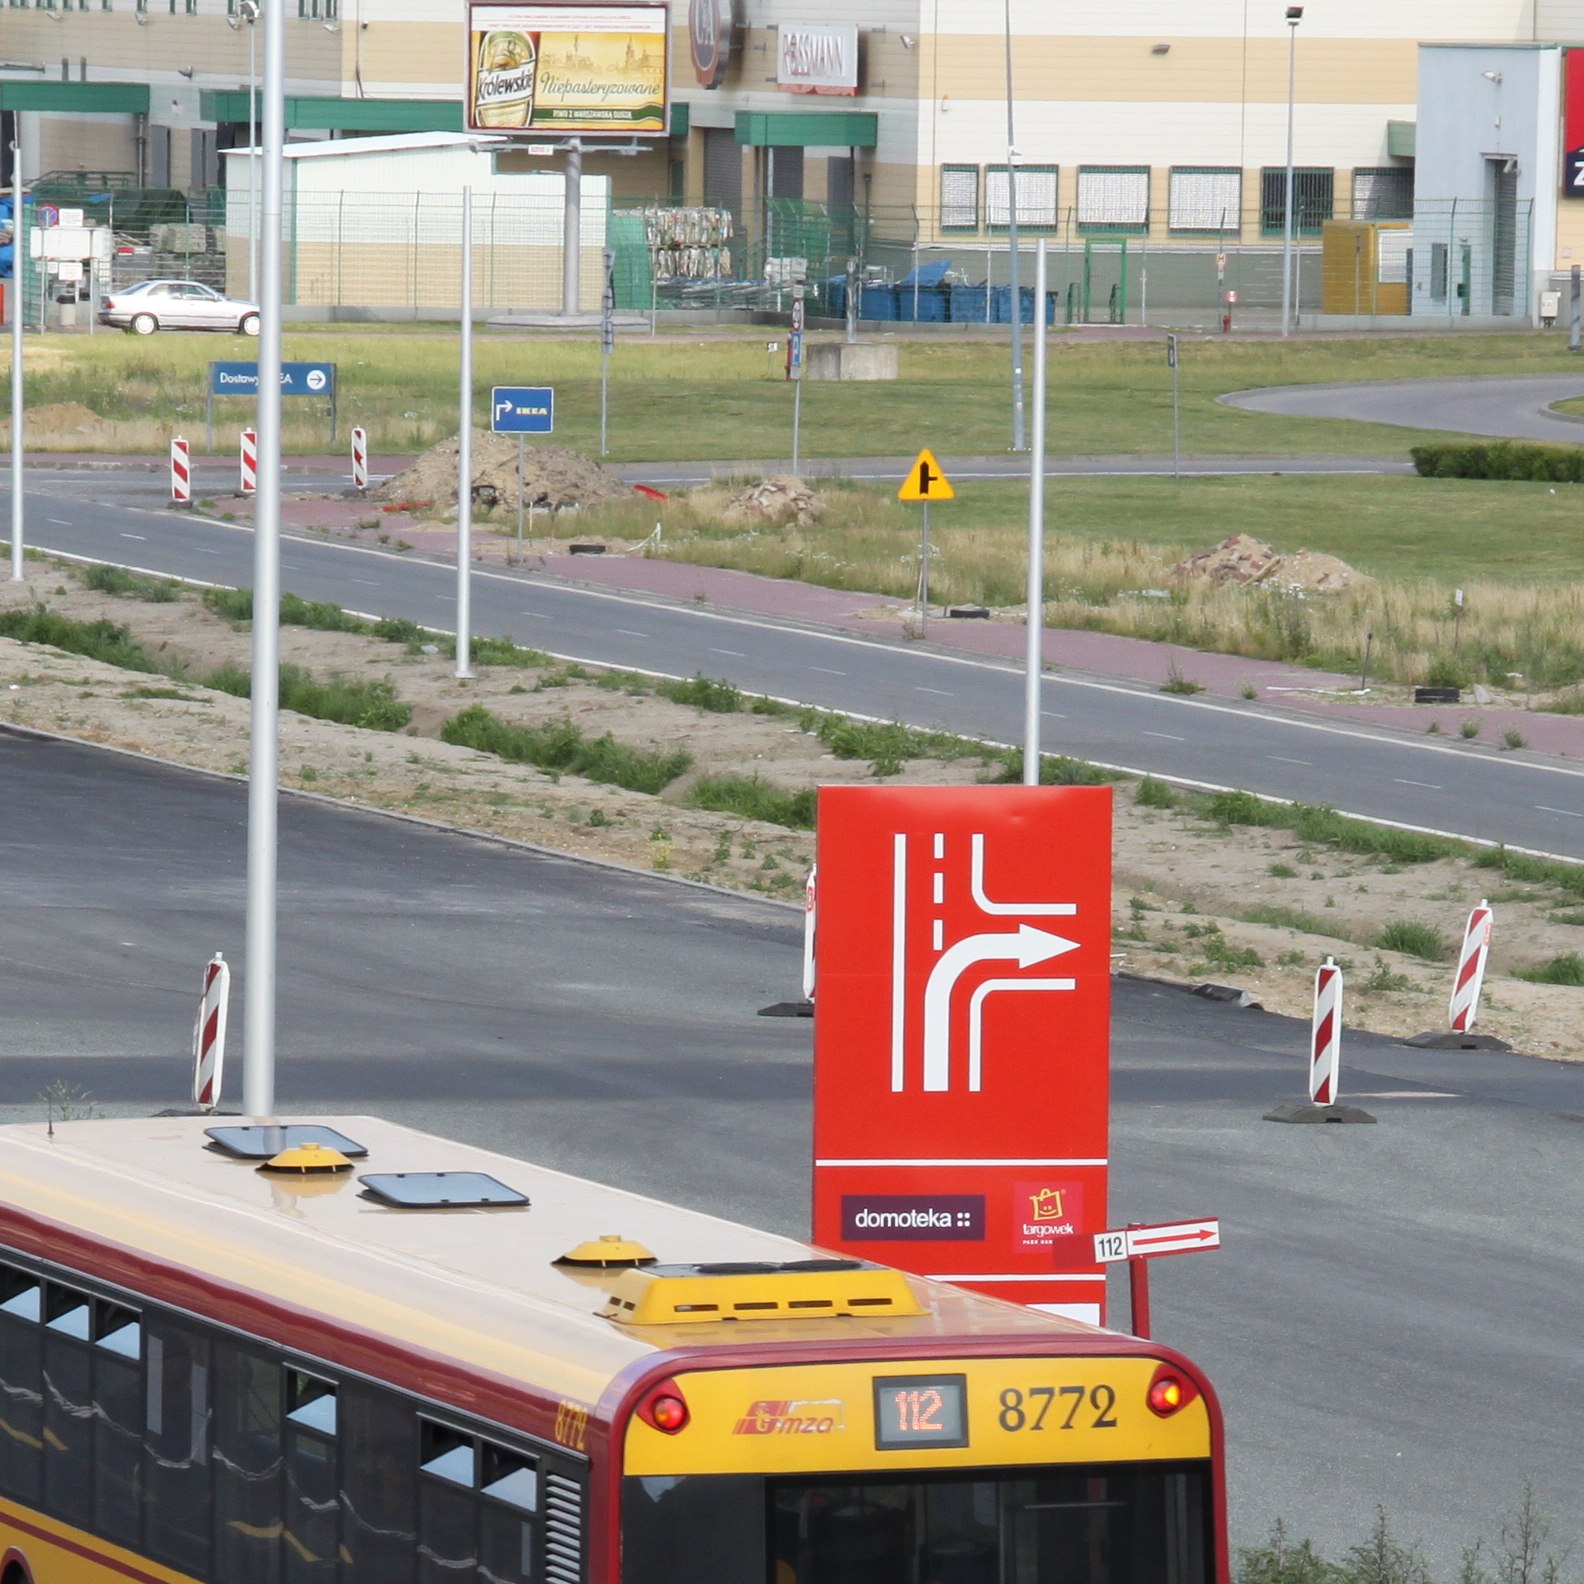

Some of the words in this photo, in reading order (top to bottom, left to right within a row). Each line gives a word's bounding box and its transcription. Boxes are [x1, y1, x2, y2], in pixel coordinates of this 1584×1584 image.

[478, 69, 534, 101] Królewskie
[540, 71, 662, 102] Niepasteryzowane
[219, 372, 259, 387] Dostawy
[516, 407, 548, 415] IKEA
[855, 1208, 952, 1228] domoteka
[1098, 1236, 1123, 1257] 112
[895, 1390, 943, 1430] 112
[998, 1384, 1118, 1432] 8772
[555, 1399, 588, 1451] 8772
